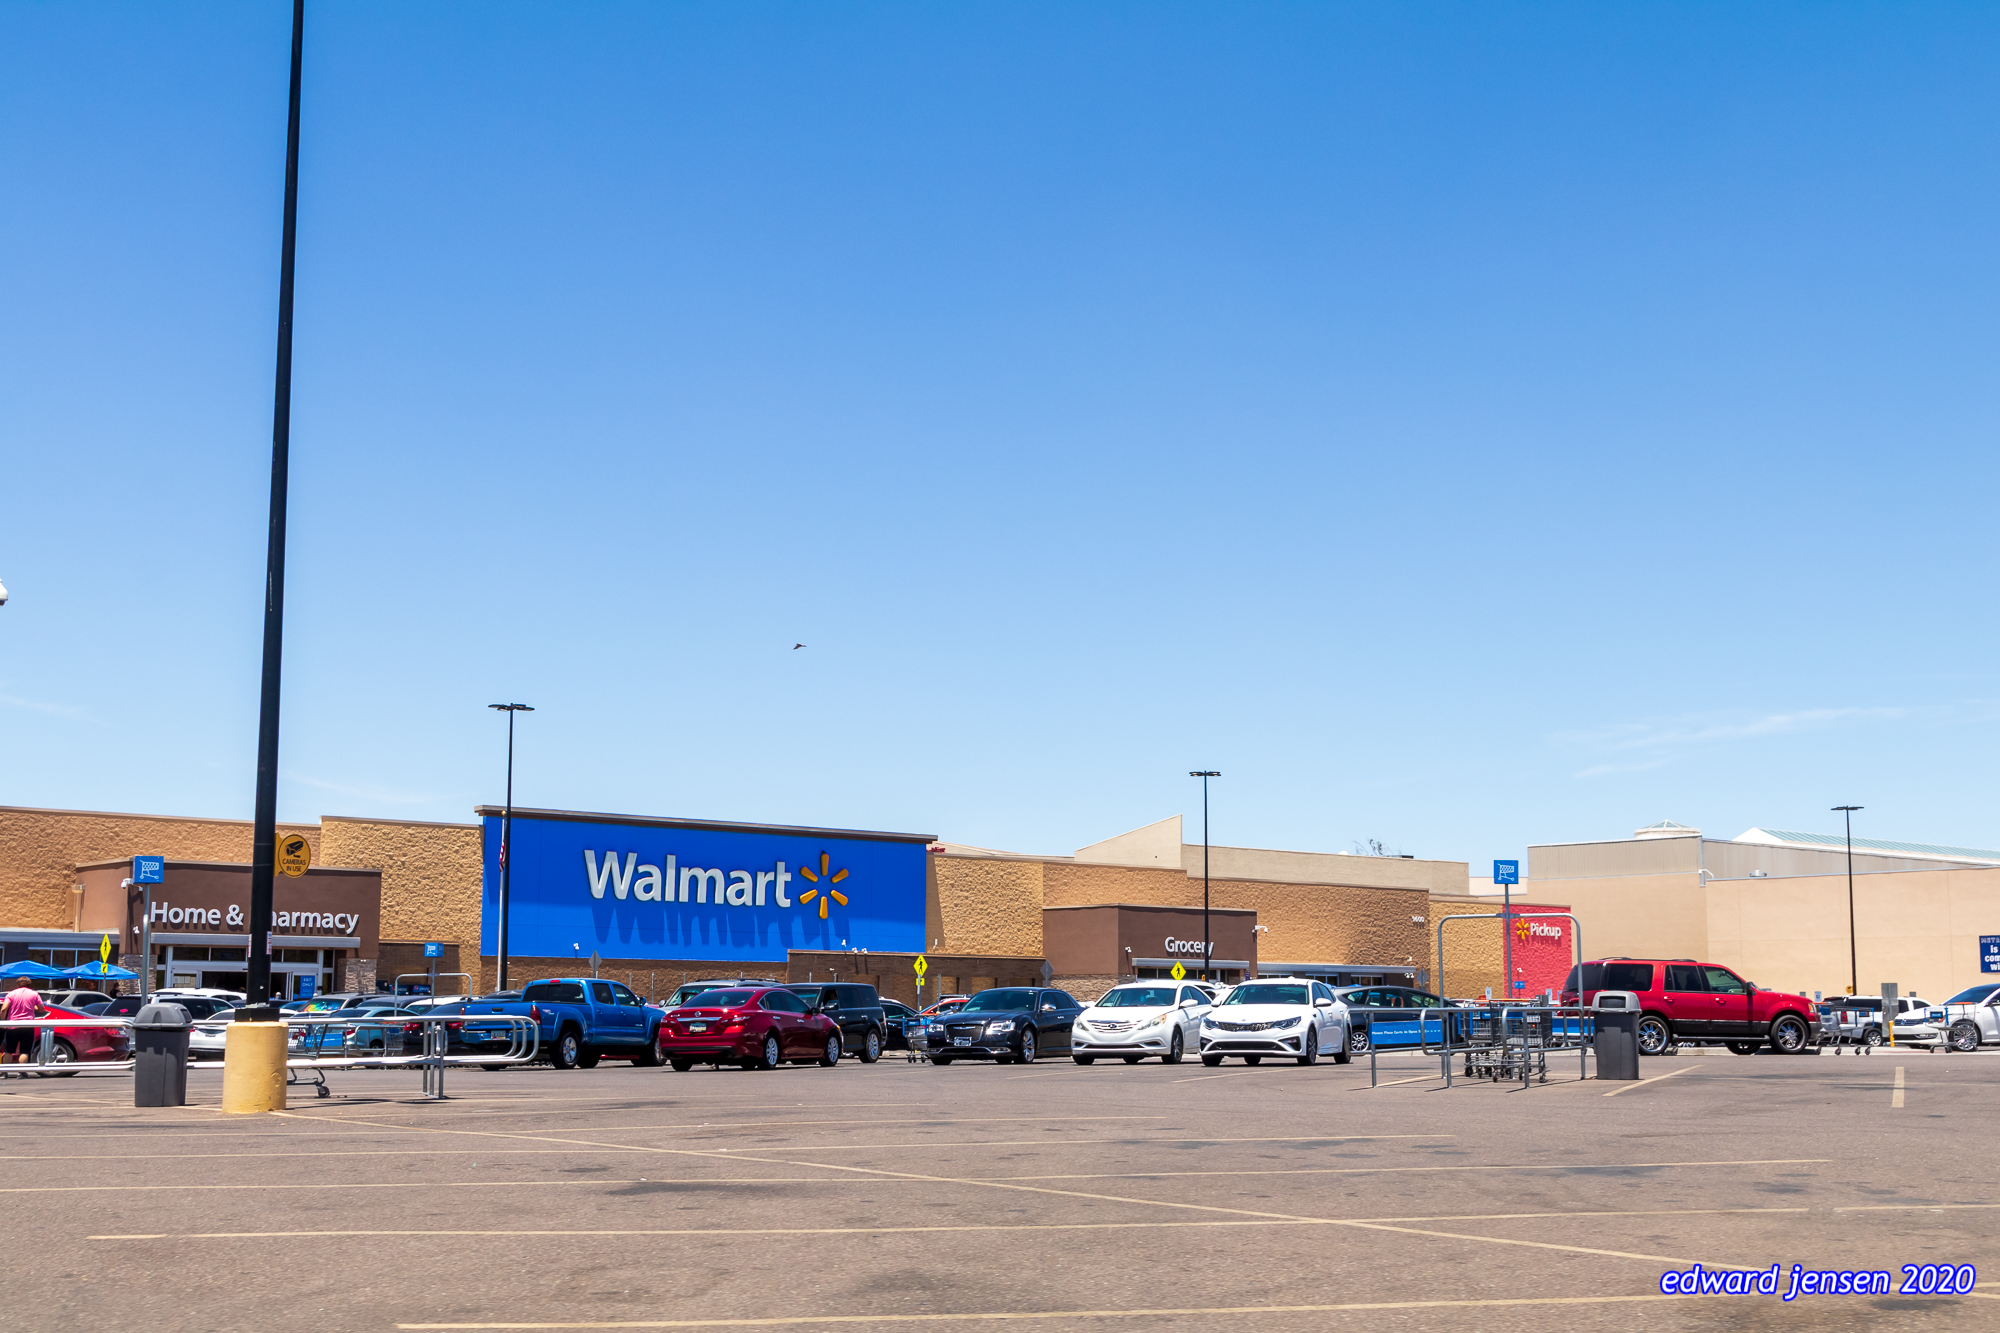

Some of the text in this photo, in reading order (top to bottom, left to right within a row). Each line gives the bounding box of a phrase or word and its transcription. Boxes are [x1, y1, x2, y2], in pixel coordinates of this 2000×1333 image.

[584, 850, 791, 908] Walmart
[151, 902, 221, 925] Home
[226, 904, 244, 926] &
[1530, 922, 1562, 940] Pickup
[1990, 944, 1998, 953] is
